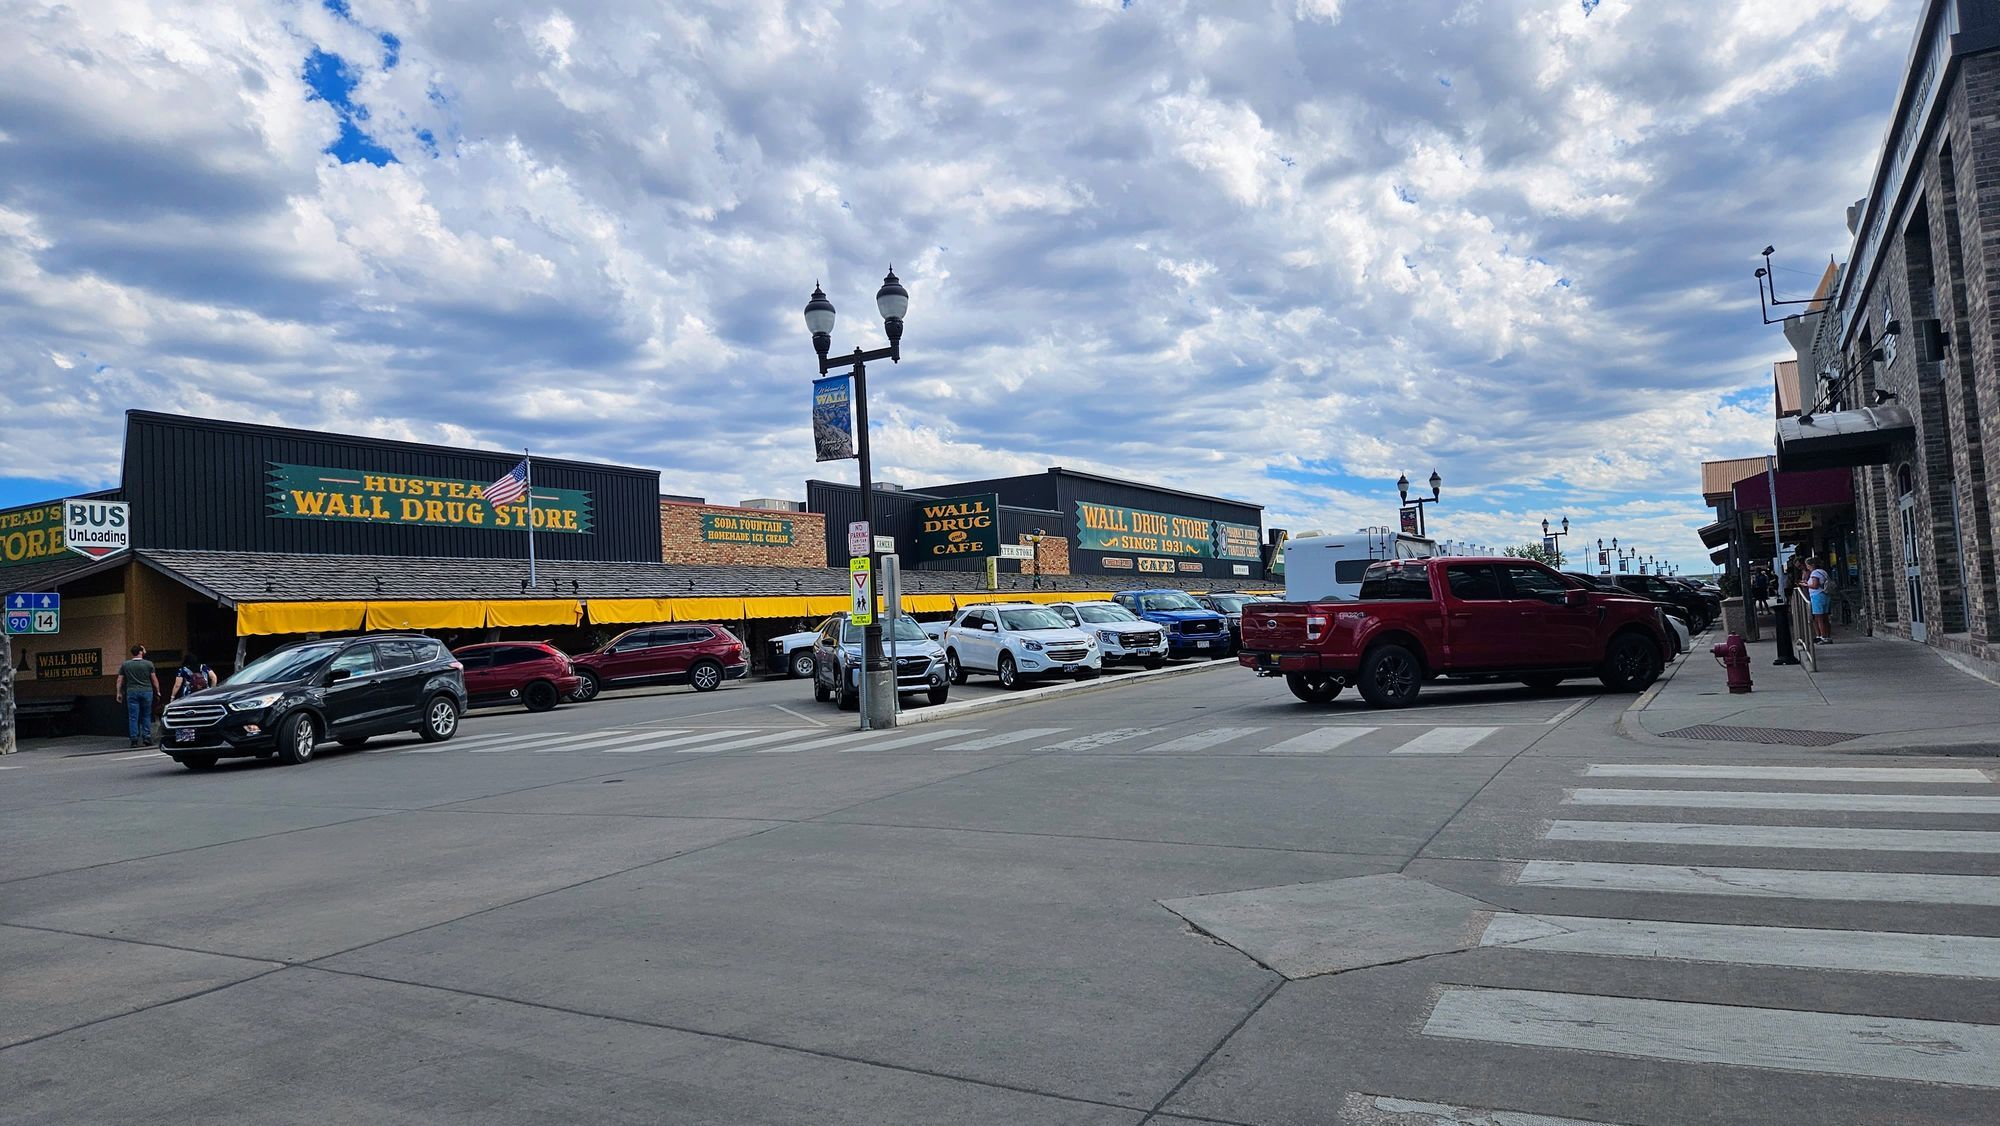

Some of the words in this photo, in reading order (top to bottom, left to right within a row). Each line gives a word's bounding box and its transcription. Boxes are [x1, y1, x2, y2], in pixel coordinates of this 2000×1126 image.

[816, 391, 848, 404] WALL
[363, 475, 526, 503] HUSTEA
[70, 504, 125, 527] BUS
[290, 490, 390, 519] WALL
[400, 498, 484, 525] DRUG
[495, 505, 577, 530] STORE
[923, 501, 990, 518] WALL
[714, 517, 737, 529] SODA
[740, 519, 782, 532] FOUNTAIN
[924, 516, 991, 532] DRUG
[1082, 505, 1128, 532] WALL
[1132, 512, 1168, 536] DRUG
[1172, 517, 1209, 540] STORE
[69, 529, 126, 545] UnLoading
[708, 531, 750, 541] HOMEMADE
[752, 533, 764, 542] ICE
[766, 534, 788, 543] CREAM
[951, 532, 963, 541] and
[933, 541, 983, 554] CAFE
[1121, 535, 1157, 551] SINCE
[1162, 540, 1184, 553] 1931
[1016, 548, 1033, 557] STORE
[1141, 559, 1175, 572] CAFE
[11, 618, 28, 629] 90
[38, 615, 53, 628] 14
[39, 655, 67, 666] WALL
[71, 652, 97, 664] DRUG
[44, 669, 60, 678] MAIN
